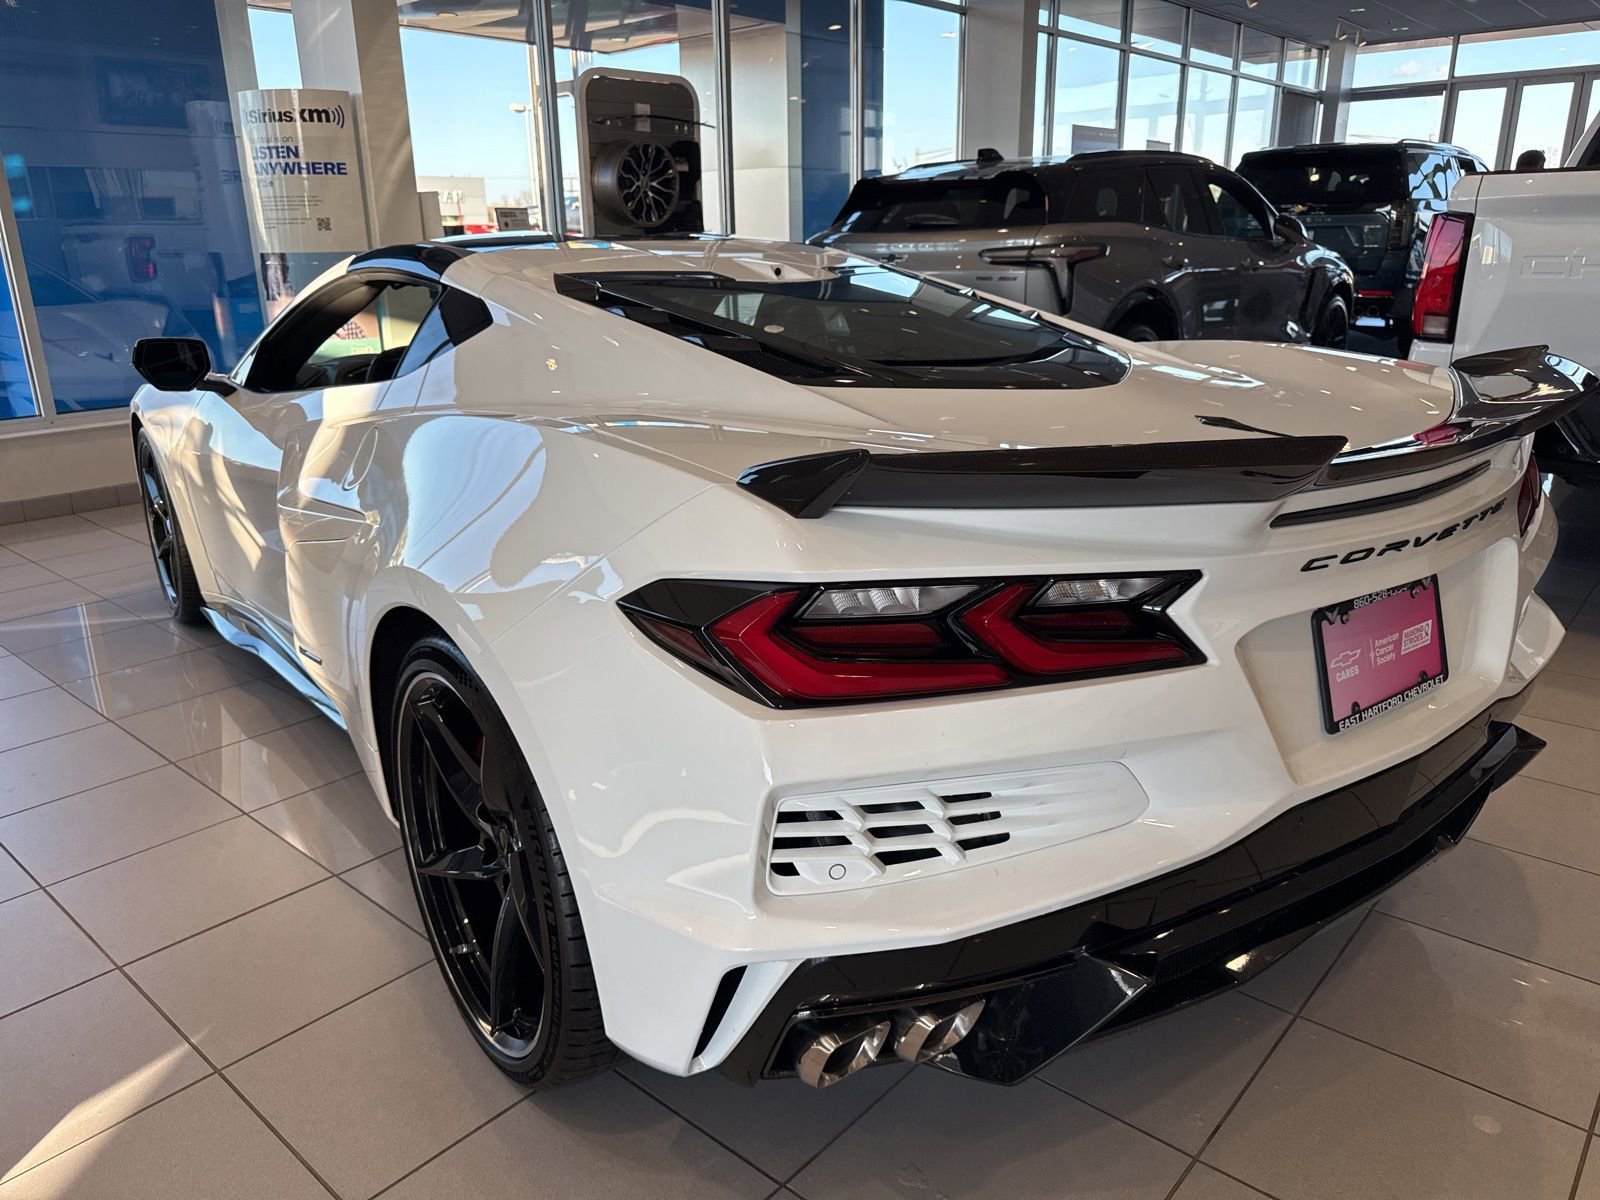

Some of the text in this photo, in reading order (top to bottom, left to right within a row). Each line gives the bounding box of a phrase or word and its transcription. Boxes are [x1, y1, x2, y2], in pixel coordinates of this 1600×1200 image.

[1300, 497, 1507, 572] CORVETTE
[1353, 587, 1408, 609] 860-528-1
[1374, 632, 1400, 648] American
[1375, 643, 1395, 657] Cancer
[1376, 652, 1396, 666] Society
[1336, 665, 1360, 682] CARES
[1338, 674, 1444, 732] EAST HARTFORD CHEVROLET
[527, 808, 557, 928] MICHELIN
